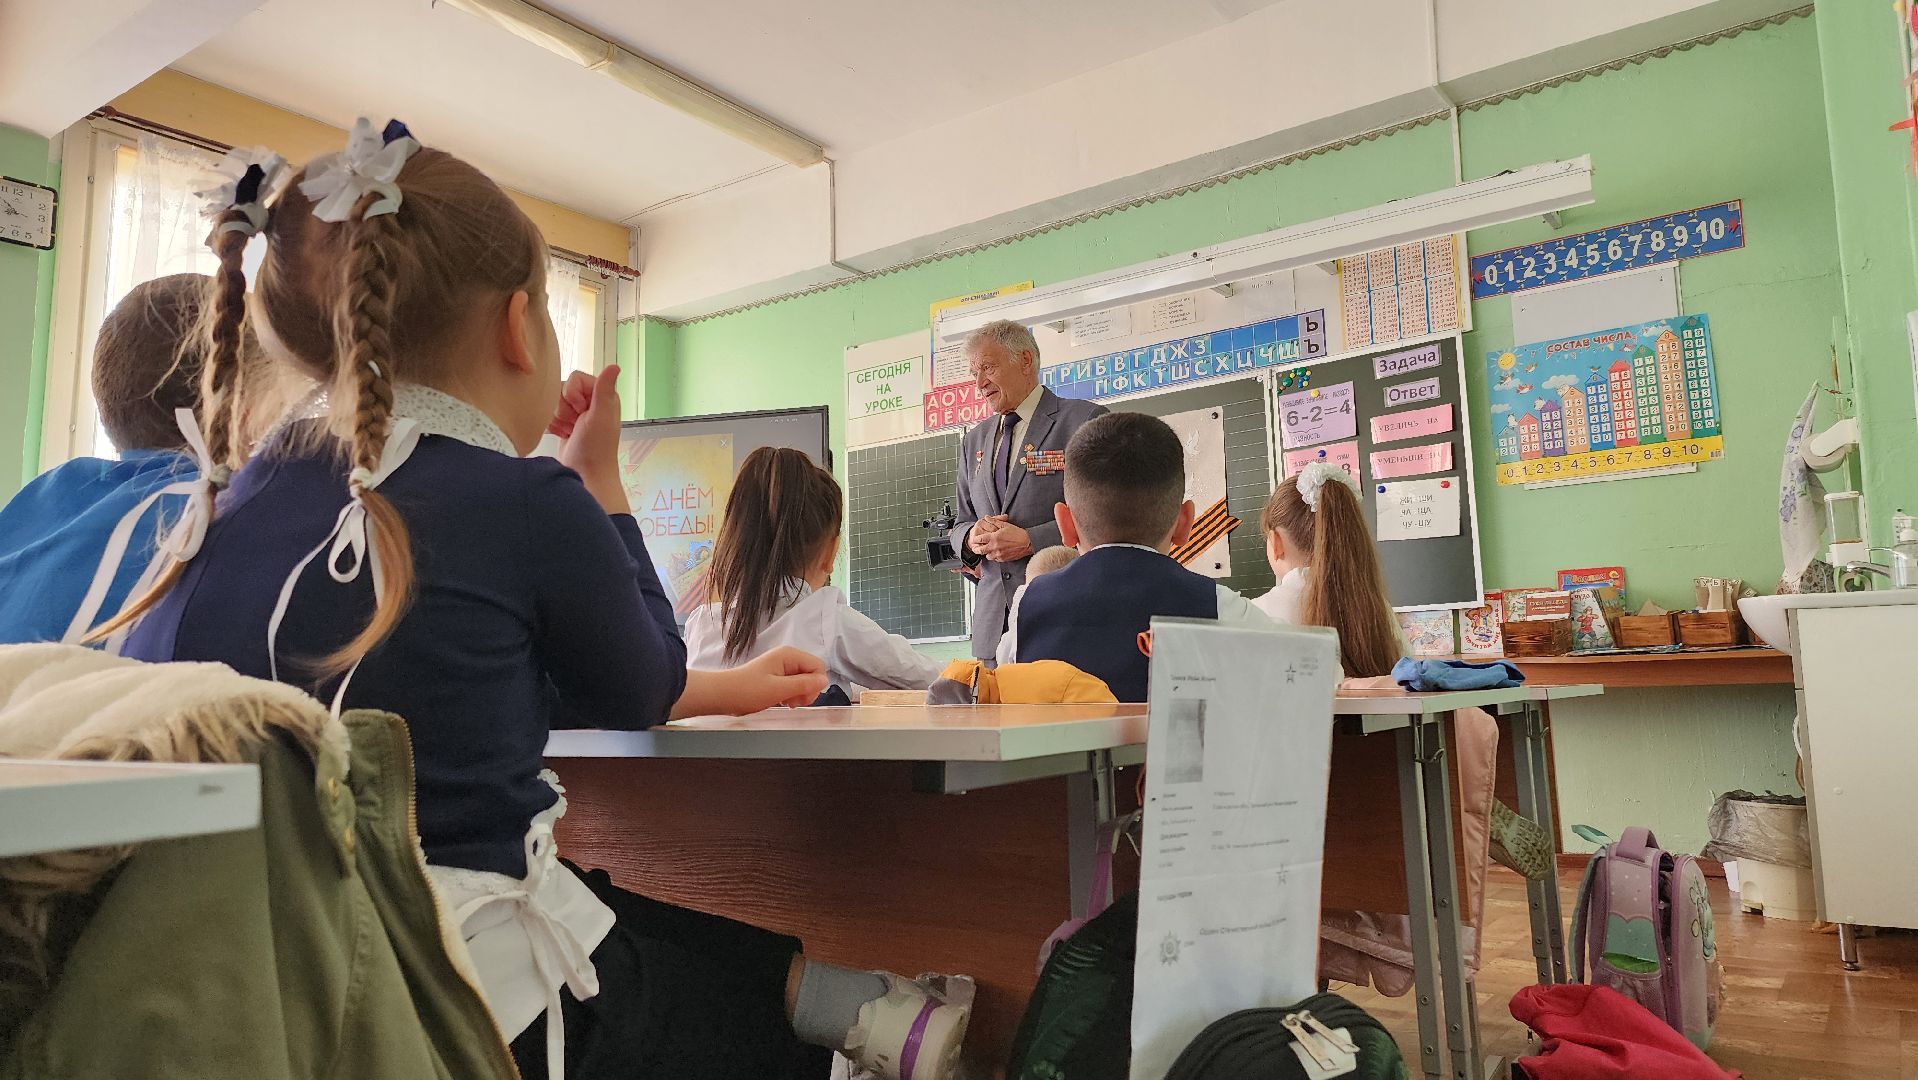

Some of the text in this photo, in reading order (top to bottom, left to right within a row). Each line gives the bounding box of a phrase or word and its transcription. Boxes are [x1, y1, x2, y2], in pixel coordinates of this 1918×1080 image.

[13, 188, 24, 196] 12
[1485, 218, 1725, 285] 0 1 2 3 4 5 6 7 8 9 10
[1306, 317, 1319, 332] Ь
[1304, 339, 1319, 354] Ъ
[1547, 332, 1632, 352] СОСТАВ ЧИСЛА
[1060, 367, 1070, 383] Р
[1096, 360, 1106, 376] Б
[1114, 356, 1125, 372] В
[1134, 352, 1144, 368] Г
[1150, 348, 1166, 367] Д
[1170, 344, 1188, 360] Ж
[1194, 340, 1206, 355] З
[1096, 379, 1108, 395] П
[1112, 376, 1128, 390] Ф
[1134, 371, 1146, 387] К
[1154, 368, 1167, 383] Т
[1171, 363, 1190, 380] Ш
[1194, 360, 1208, 375] С
[1215, 354, 1230, 372] Х
[1237, 351, 1253, 368] Ц
[1260, 346, 1273, 362] Ч
[1379, 351, 1436, 373] Задача
[856, 362, 911, 384] СЕГОДНЯ
[876, 383, 892, 396] НА
[927, 395, 939, 410] А
[942, 391, 956, 407] О
[958, 387, 970, 403] У
[1389, 383, 1436, 402] Ответ
[865, 396, 902, 414] УРОКЕ
[928, 403, 987, 427] Я Ё Ю И
[1507, 445, 1699, 477] 0 1 2 3 4 5 6 7 8 9 10
[651, 484, 714, 512] ДНЁМ
[639, 515, 714, 537] ОБЕДЫ!
